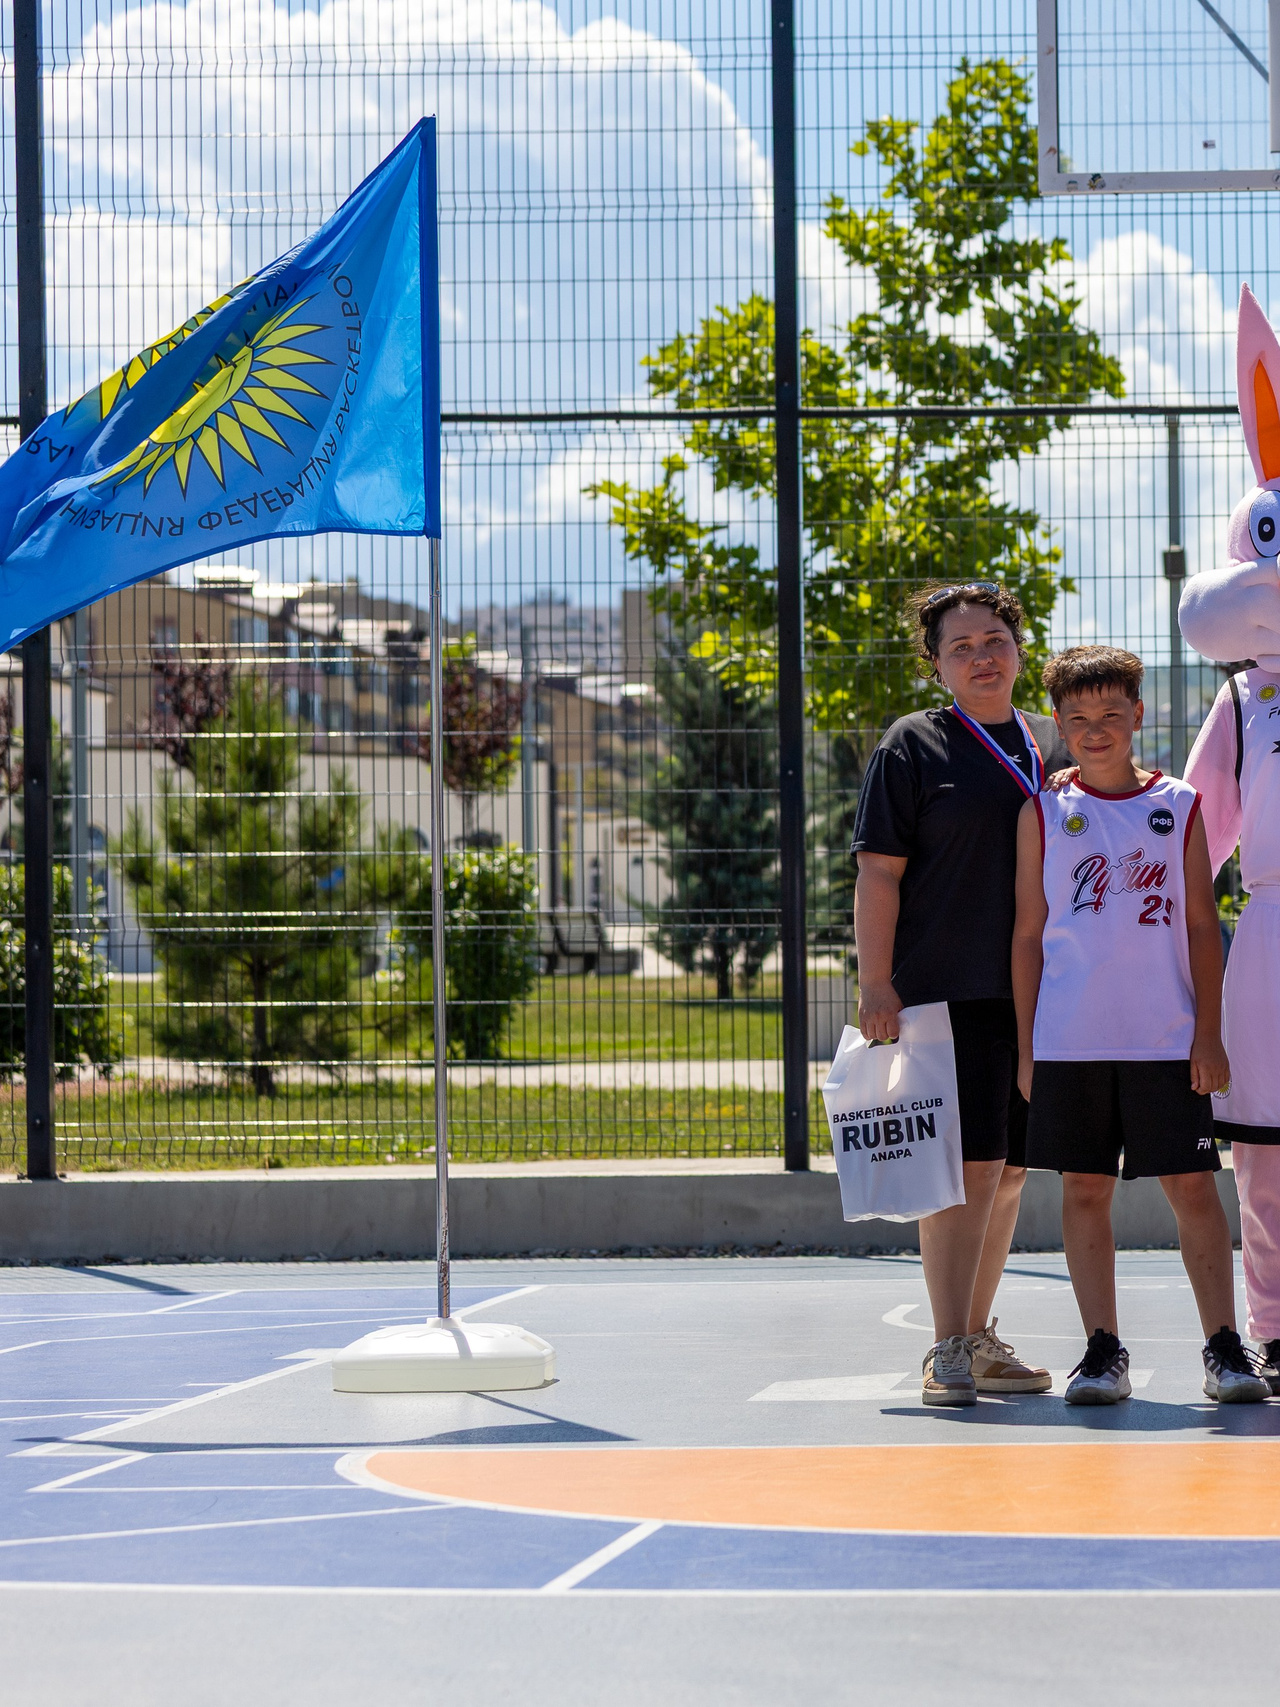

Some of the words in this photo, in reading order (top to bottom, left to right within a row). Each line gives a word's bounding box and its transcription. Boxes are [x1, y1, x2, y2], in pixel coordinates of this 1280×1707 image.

[1152, 817, 1173, 827] РФБ
[1071, 847, 1168, 915] Рубин
[833, 1104, 908, 1123] BASKETBALL
[911, 1097, 944, 1111] CLUB
[842, 1112, 937, 1153] RUBIN
[870, 1148, 913, 1163] ANAPA
